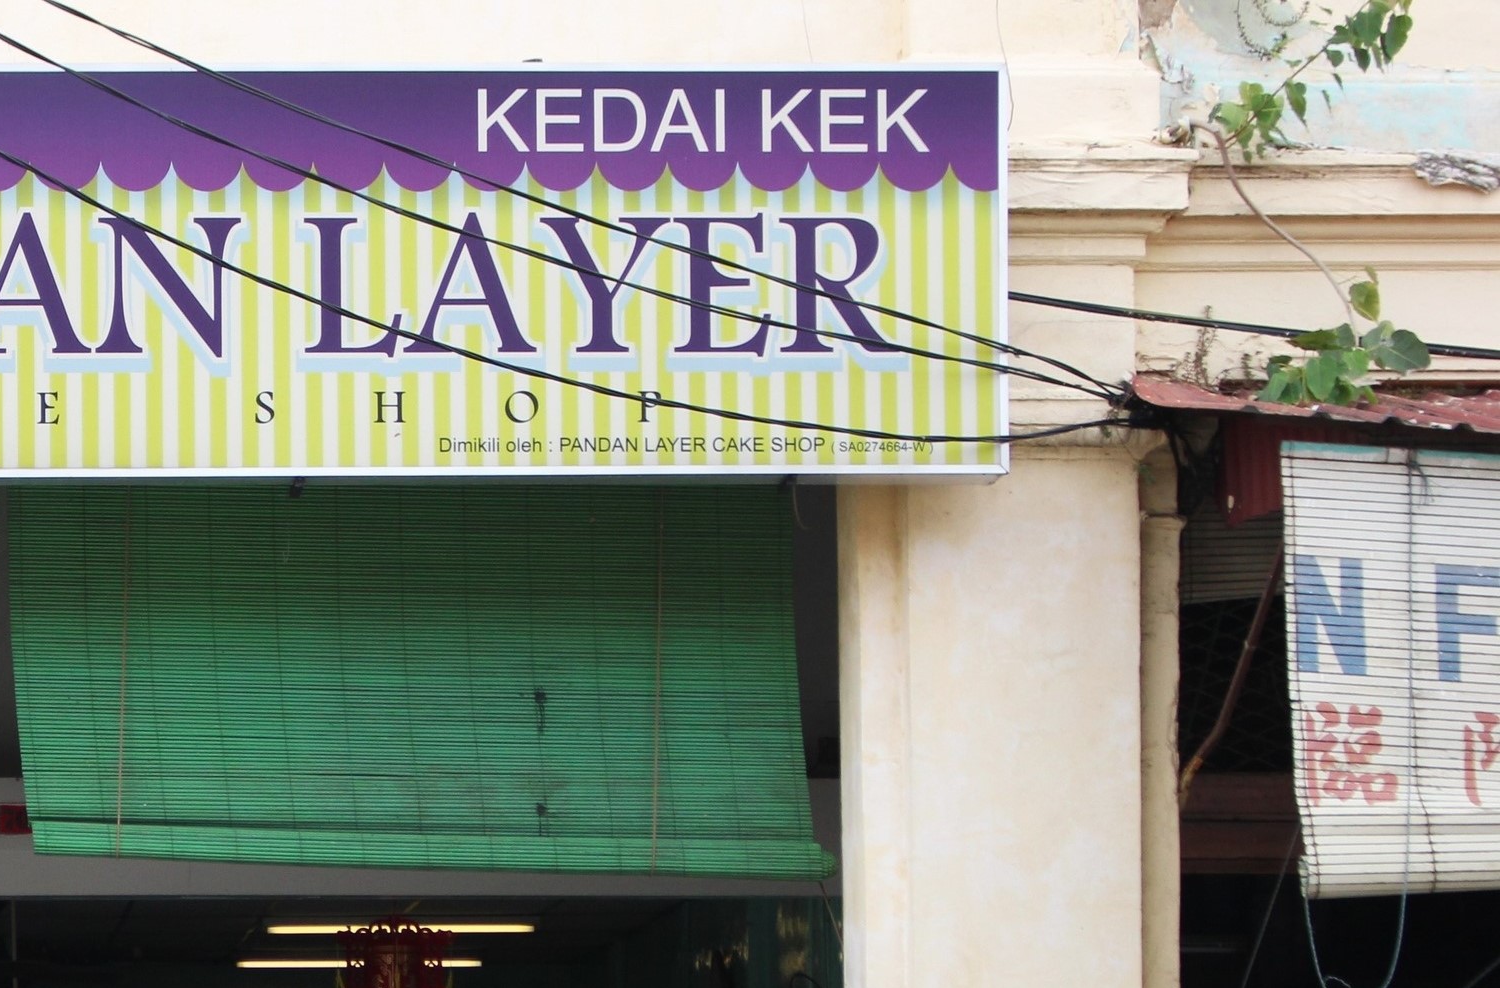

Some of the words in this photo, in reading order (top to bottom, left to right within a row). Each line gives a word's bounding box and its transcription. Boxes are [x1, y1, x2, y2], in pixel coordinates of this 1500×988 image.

[476, 88, 727, 153] KEDAI
[762, 88, 930, 153] KEK
[303, 211, 902, 358] LAYER
[254, 390, 662, 425] SHOP
[439, 437, 500, 454] Dimikili
[505, 437, 542, 454] oleh
[559, 437, 638, 453] PANDAN
[645, 437, 706, 453] LAYER
[712, 437, 765, 453] CAKE
[771, 437, 826, 453] SHOP
